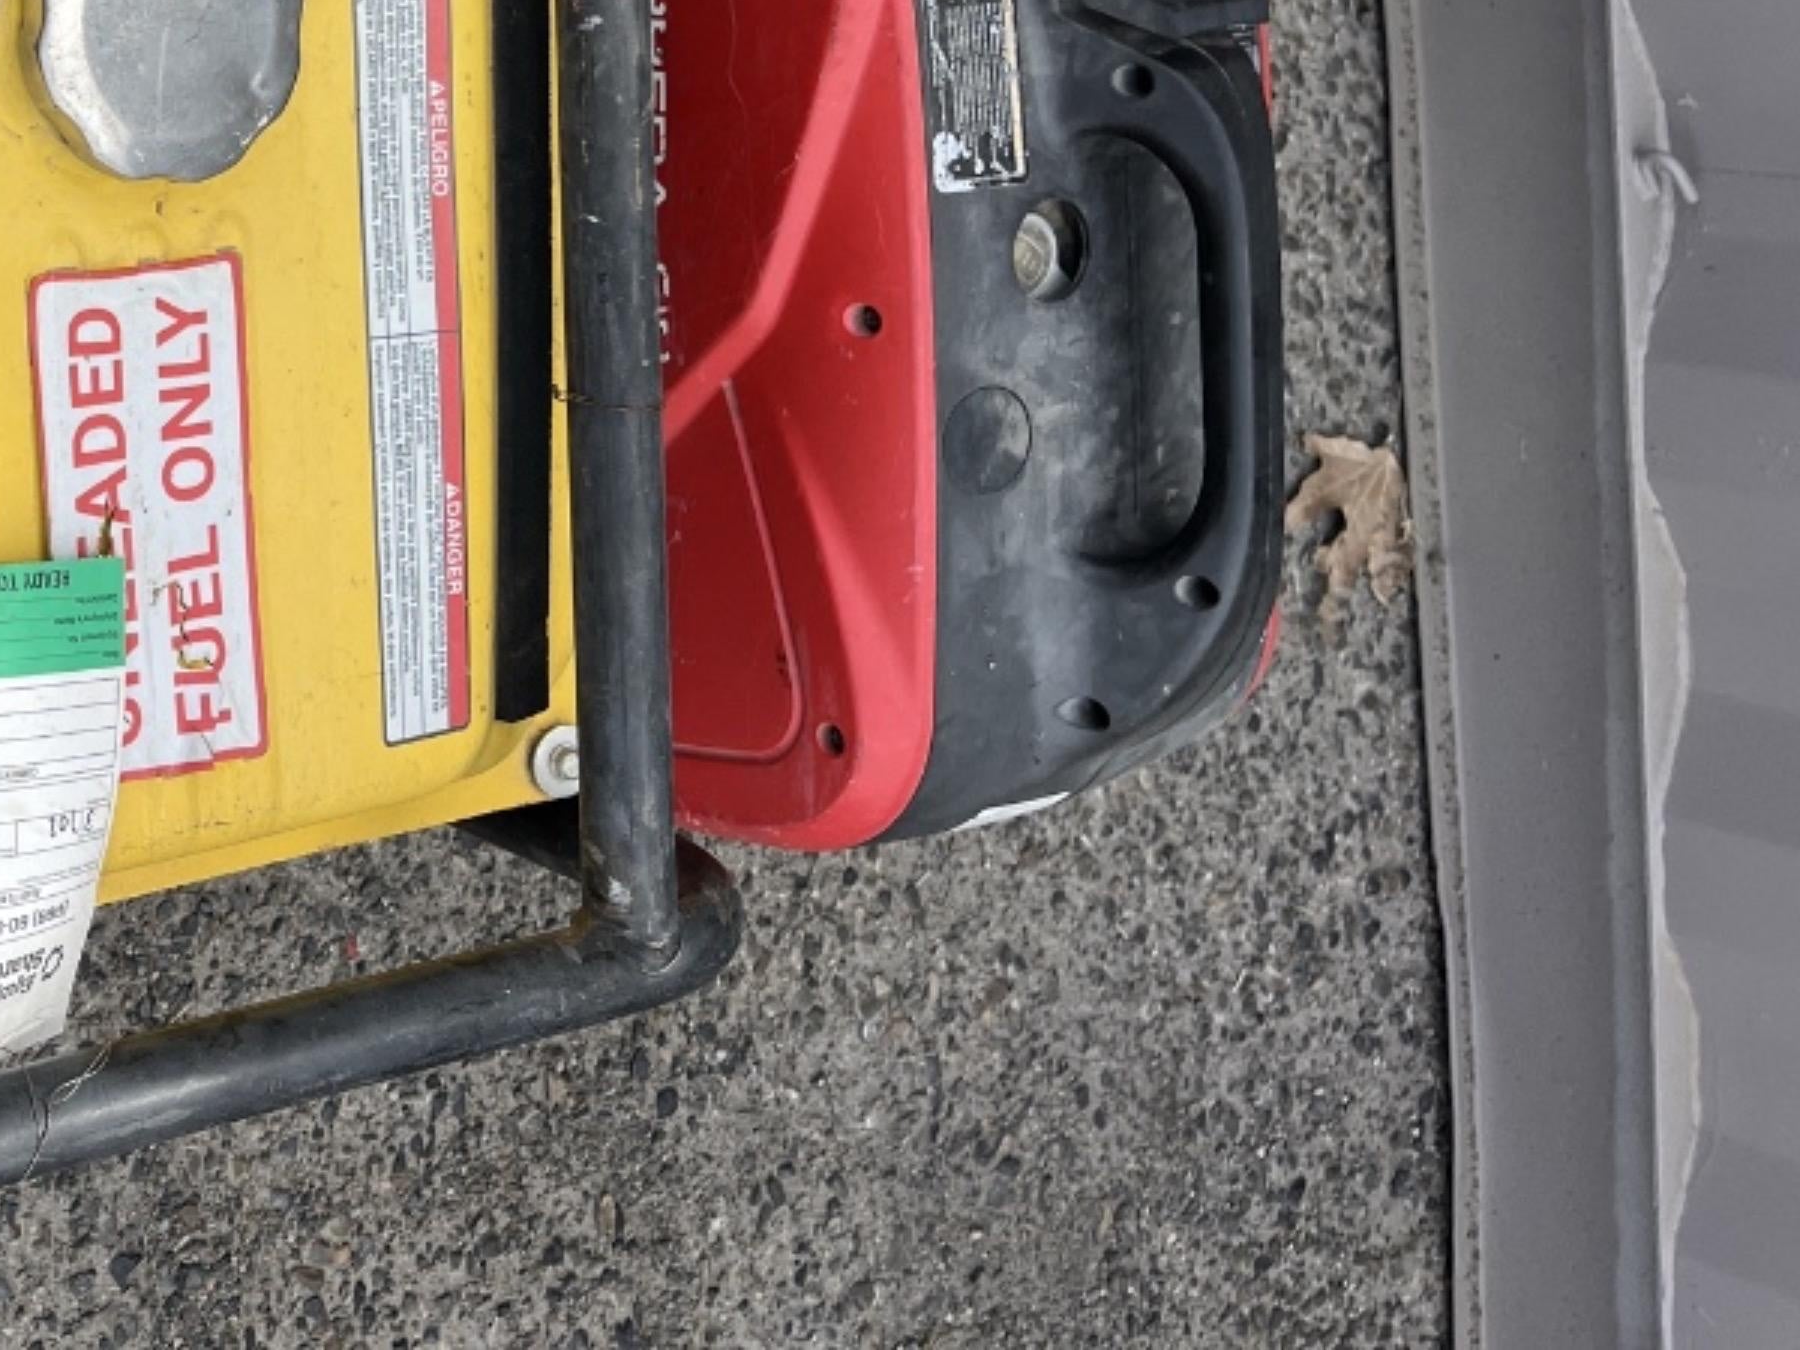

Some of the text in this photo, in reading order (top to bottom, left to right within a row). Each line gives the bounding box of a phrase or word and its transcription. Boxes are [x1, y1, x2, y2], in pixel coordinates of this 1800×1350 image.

[429, 97, 450, 197] PELIGRO
[155, 296, 232, 736] FUEL ONLY
[446, 500, 463, 595] DANGER
